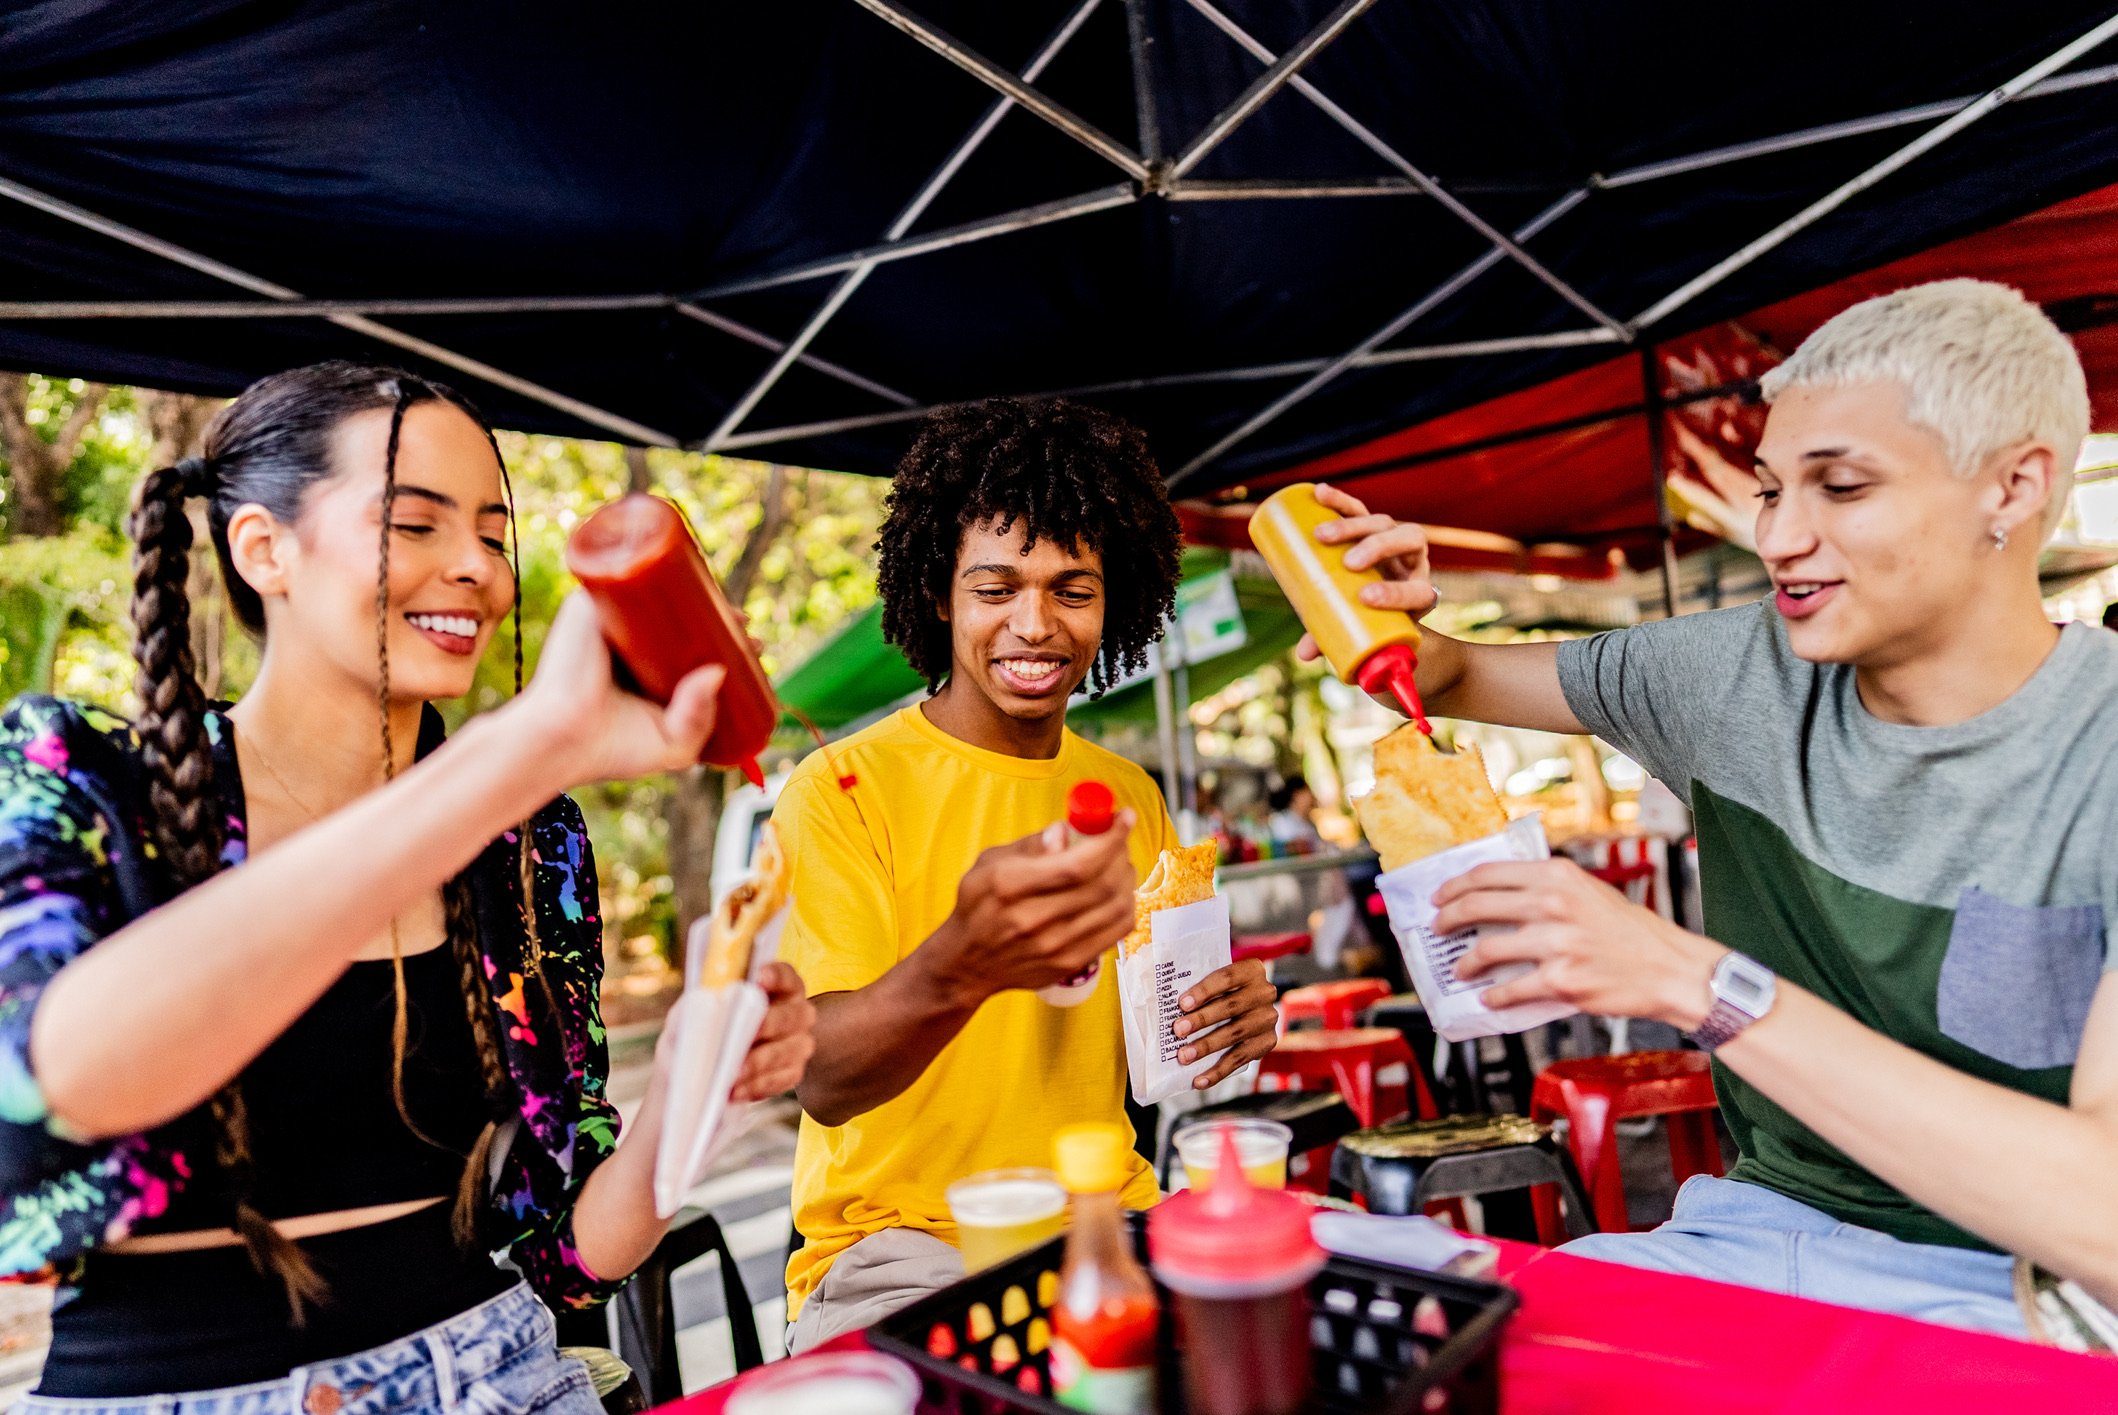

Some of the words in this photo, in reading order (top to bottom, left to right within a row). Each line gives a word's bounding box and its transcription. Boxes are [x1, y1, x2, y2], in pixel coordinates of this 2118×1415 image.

[1161, 960, 1174, 969] CARNE
[1162, 967, 1176, 977] QUEIJO
[1162, 975, 1173, 984] CARNE
[1177, 970, 1191, 979] QUEIJO
